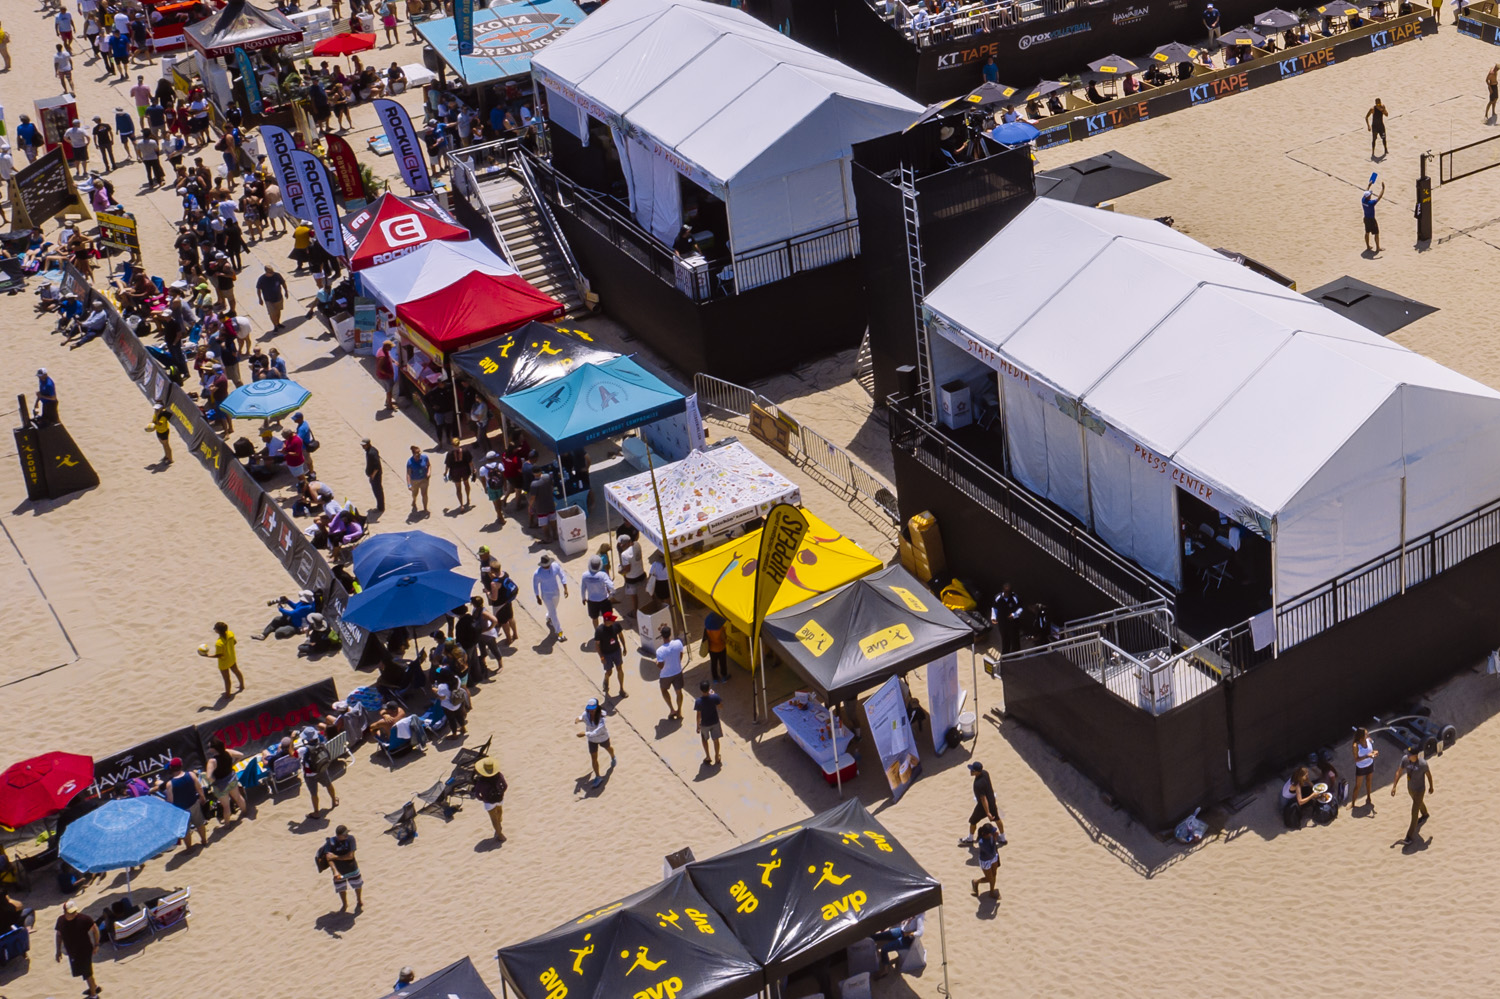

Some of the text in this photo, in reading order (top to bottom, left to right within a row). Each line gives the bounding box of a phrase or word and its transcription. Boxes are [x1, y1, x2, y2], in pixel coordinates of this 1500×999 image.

[472, 15, 533, 34] KONA
[1370, 21, 1423, 48] KT TAPE
[937, 42, 1000, 68] KT TAPE
[1279, 48, 1335, 76] KT TAPE
[1189, 72, 1249, 102] KT TAPE
[1087, 112, 1107, 131] KT
[1108, 102, 1149, 124] TAPE
[385, 105, 423, 185] ROCKWELL
[303, 159, 336, 247] ROCKWELL
[479, 356, 499, 375] avp
[967, 339, 1031, 388] STAFF MEDIA
[26, 453, 38, 485] COURT
[1134, 444, 1214, 501] PRESS CENTER
[766, 514, 804, 585] HIPPEAS
[801, 626, 815, 641] avp
[866, 638, 889, 653] avp
[213, 703, 322, 750] Wilson
[87, 748, 174, 799] HAWAIIAN
[729, 880, 760, 914] avp
[820, 889, 868, 921] avp
[684, 907, 716, 936] avp
[539, 966, 568, 999] avp
